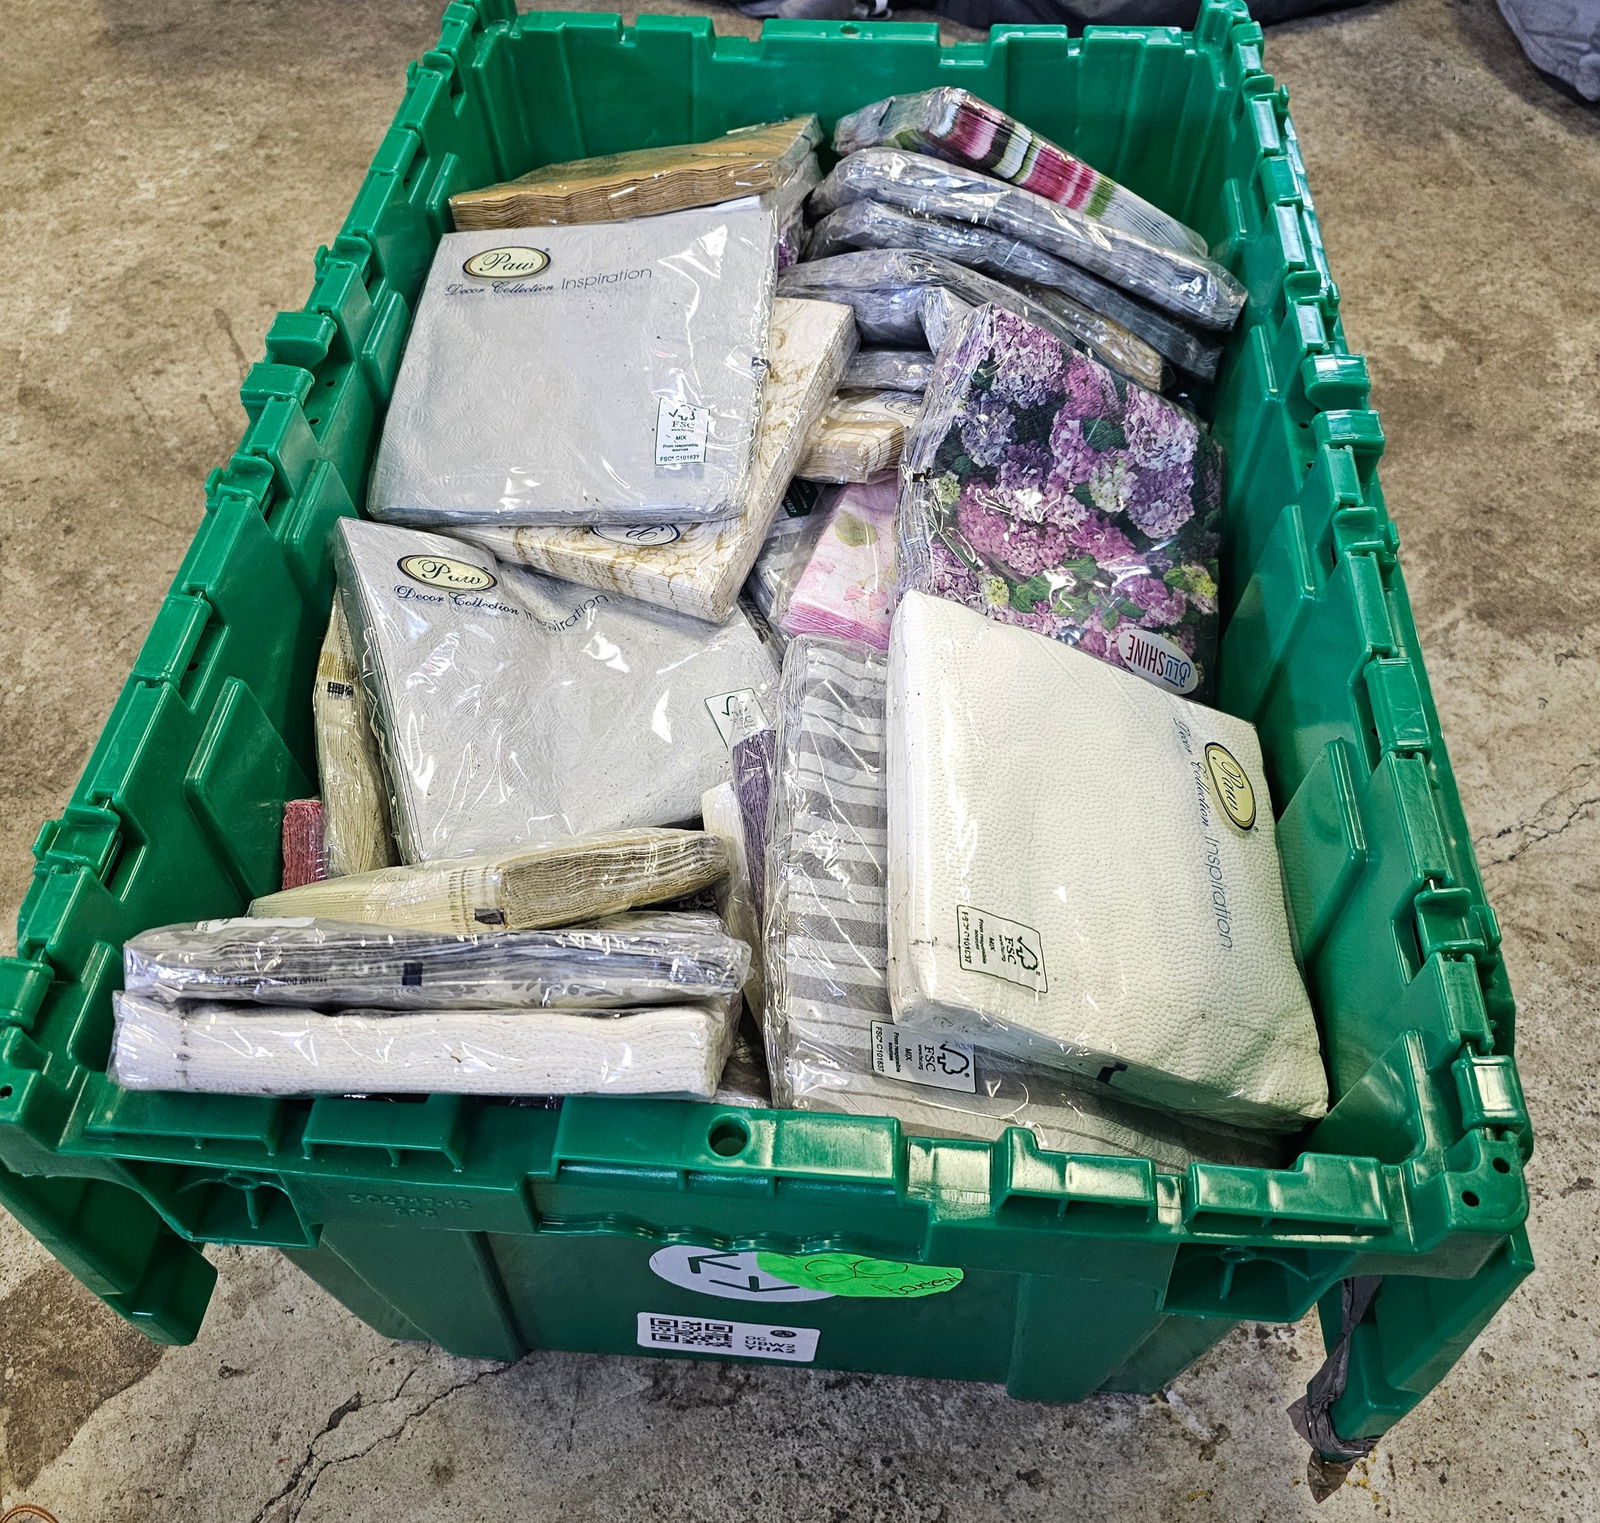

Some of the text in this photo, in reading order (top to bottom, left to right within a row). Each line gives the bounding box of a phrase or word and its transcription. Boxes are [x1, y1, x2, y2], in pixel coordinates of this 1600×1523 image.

[479, 252, 535, 272] Paw
[445, 268, 652, 296] Decor Collection Inspiration
[418, 559, 483, 585] Paw
[393, 585, 445, 602] Decor
[449, 592, 519, 615] Collection
[1212, 757, 1245, 811] Paw
[1190, 761, 1211, 827] Collection
[1205, 836, 1234, 950] Inspiration
[1004, 936, 1017, 965] FSC
[924, 1045, 936, 1072] FSC
